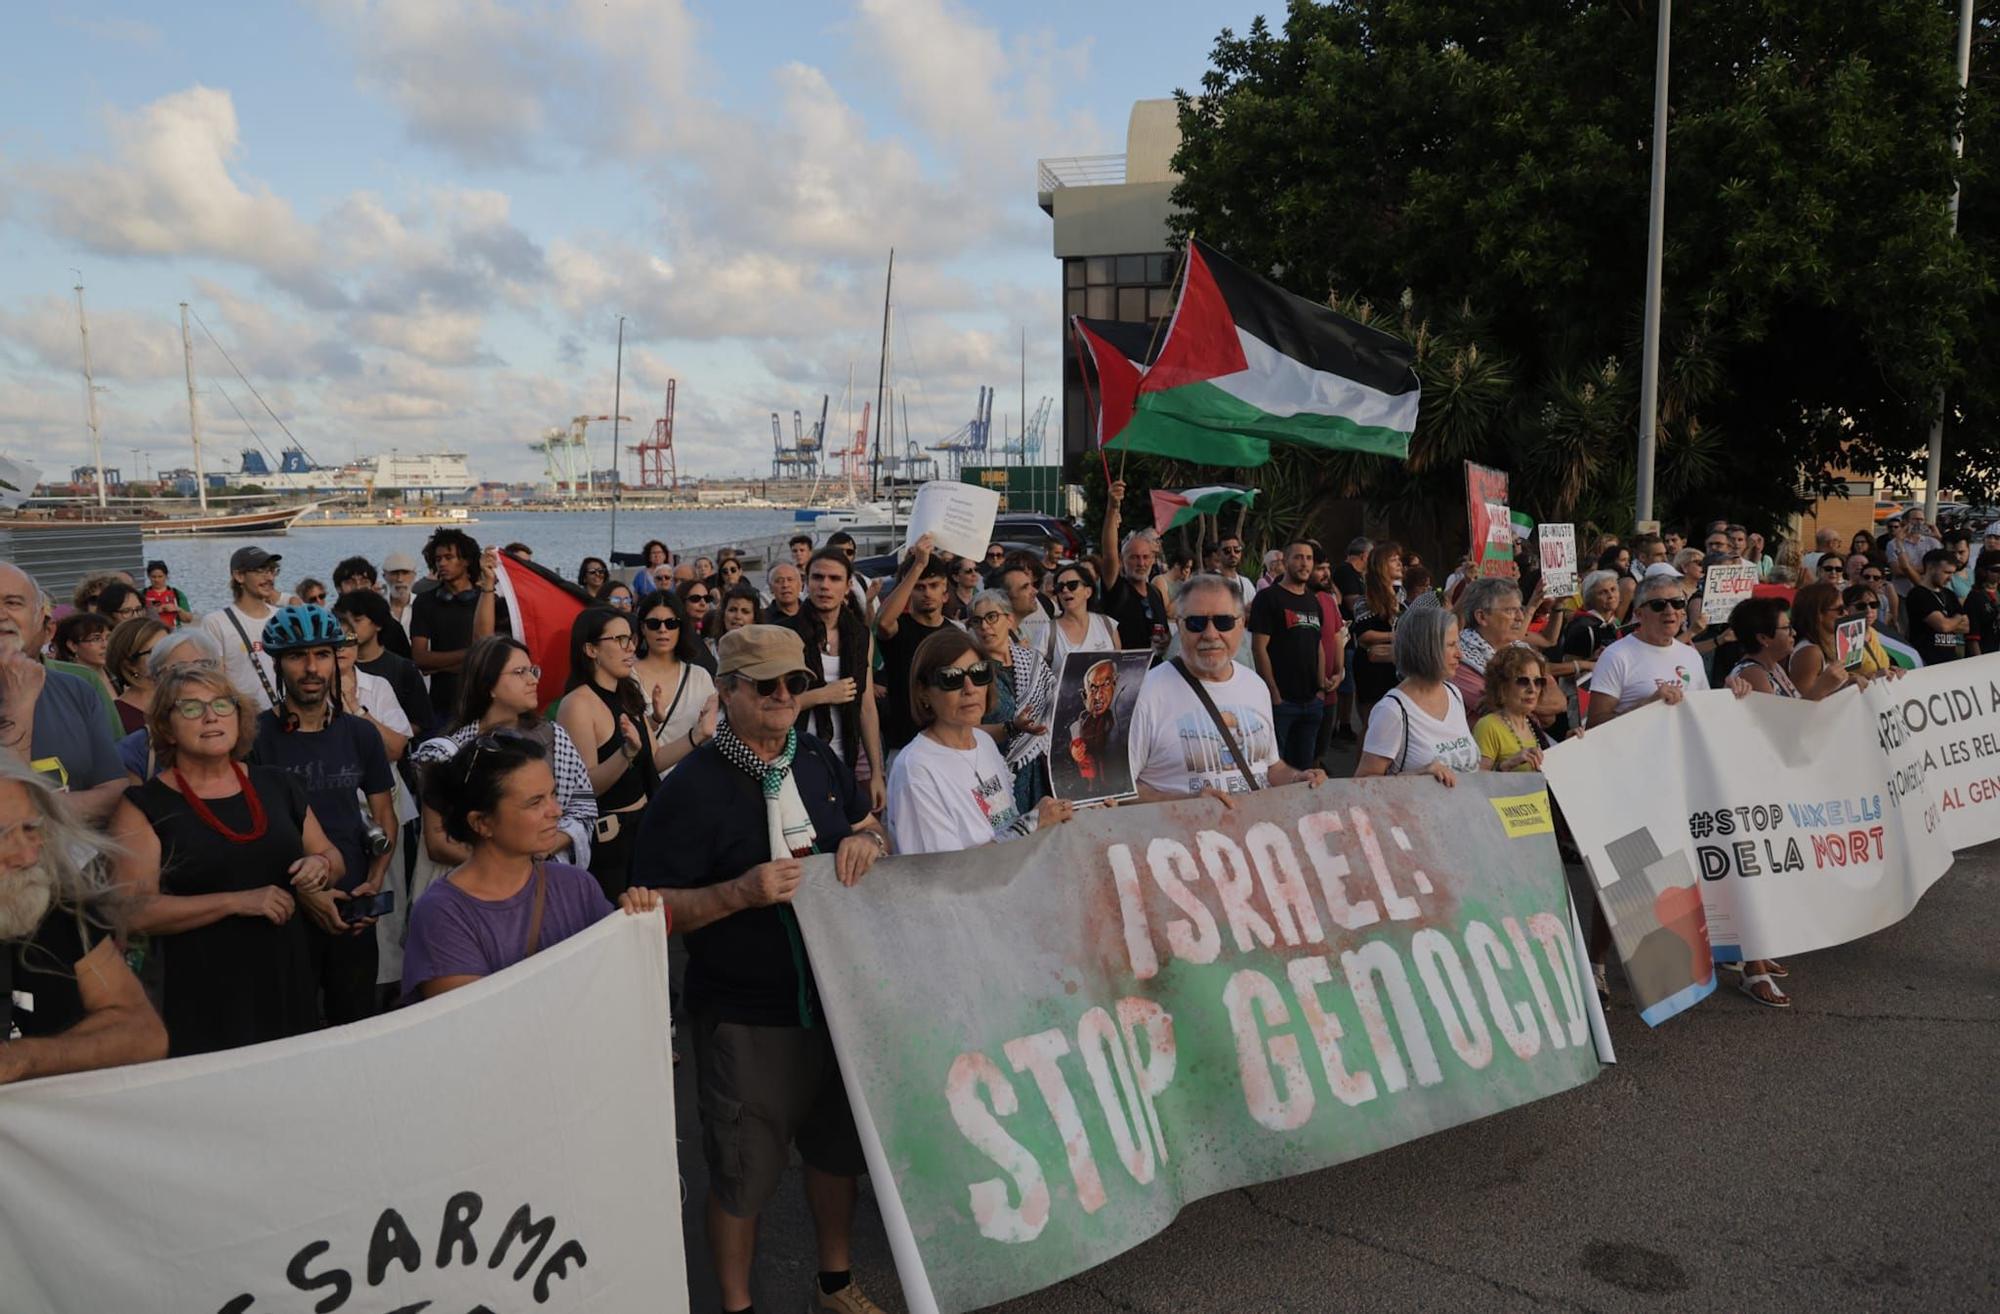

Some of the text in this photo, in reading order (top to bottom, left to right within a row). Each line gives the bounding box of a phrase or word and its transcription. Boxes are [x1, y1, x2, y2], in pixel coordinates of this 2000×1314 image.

[1541, 541, 1567, 568] NUNCA
[1941, 741, 1970, 766] LES
[1942, 788, 1965, 812] AL
[1690, 804, 1783, 838] #STOP
[1697, 826, 1884, 881] DE LA MORT
[1107, 806, 1434, 980] ISRAEL:
[945, 996, 1176, 1243] STOP
